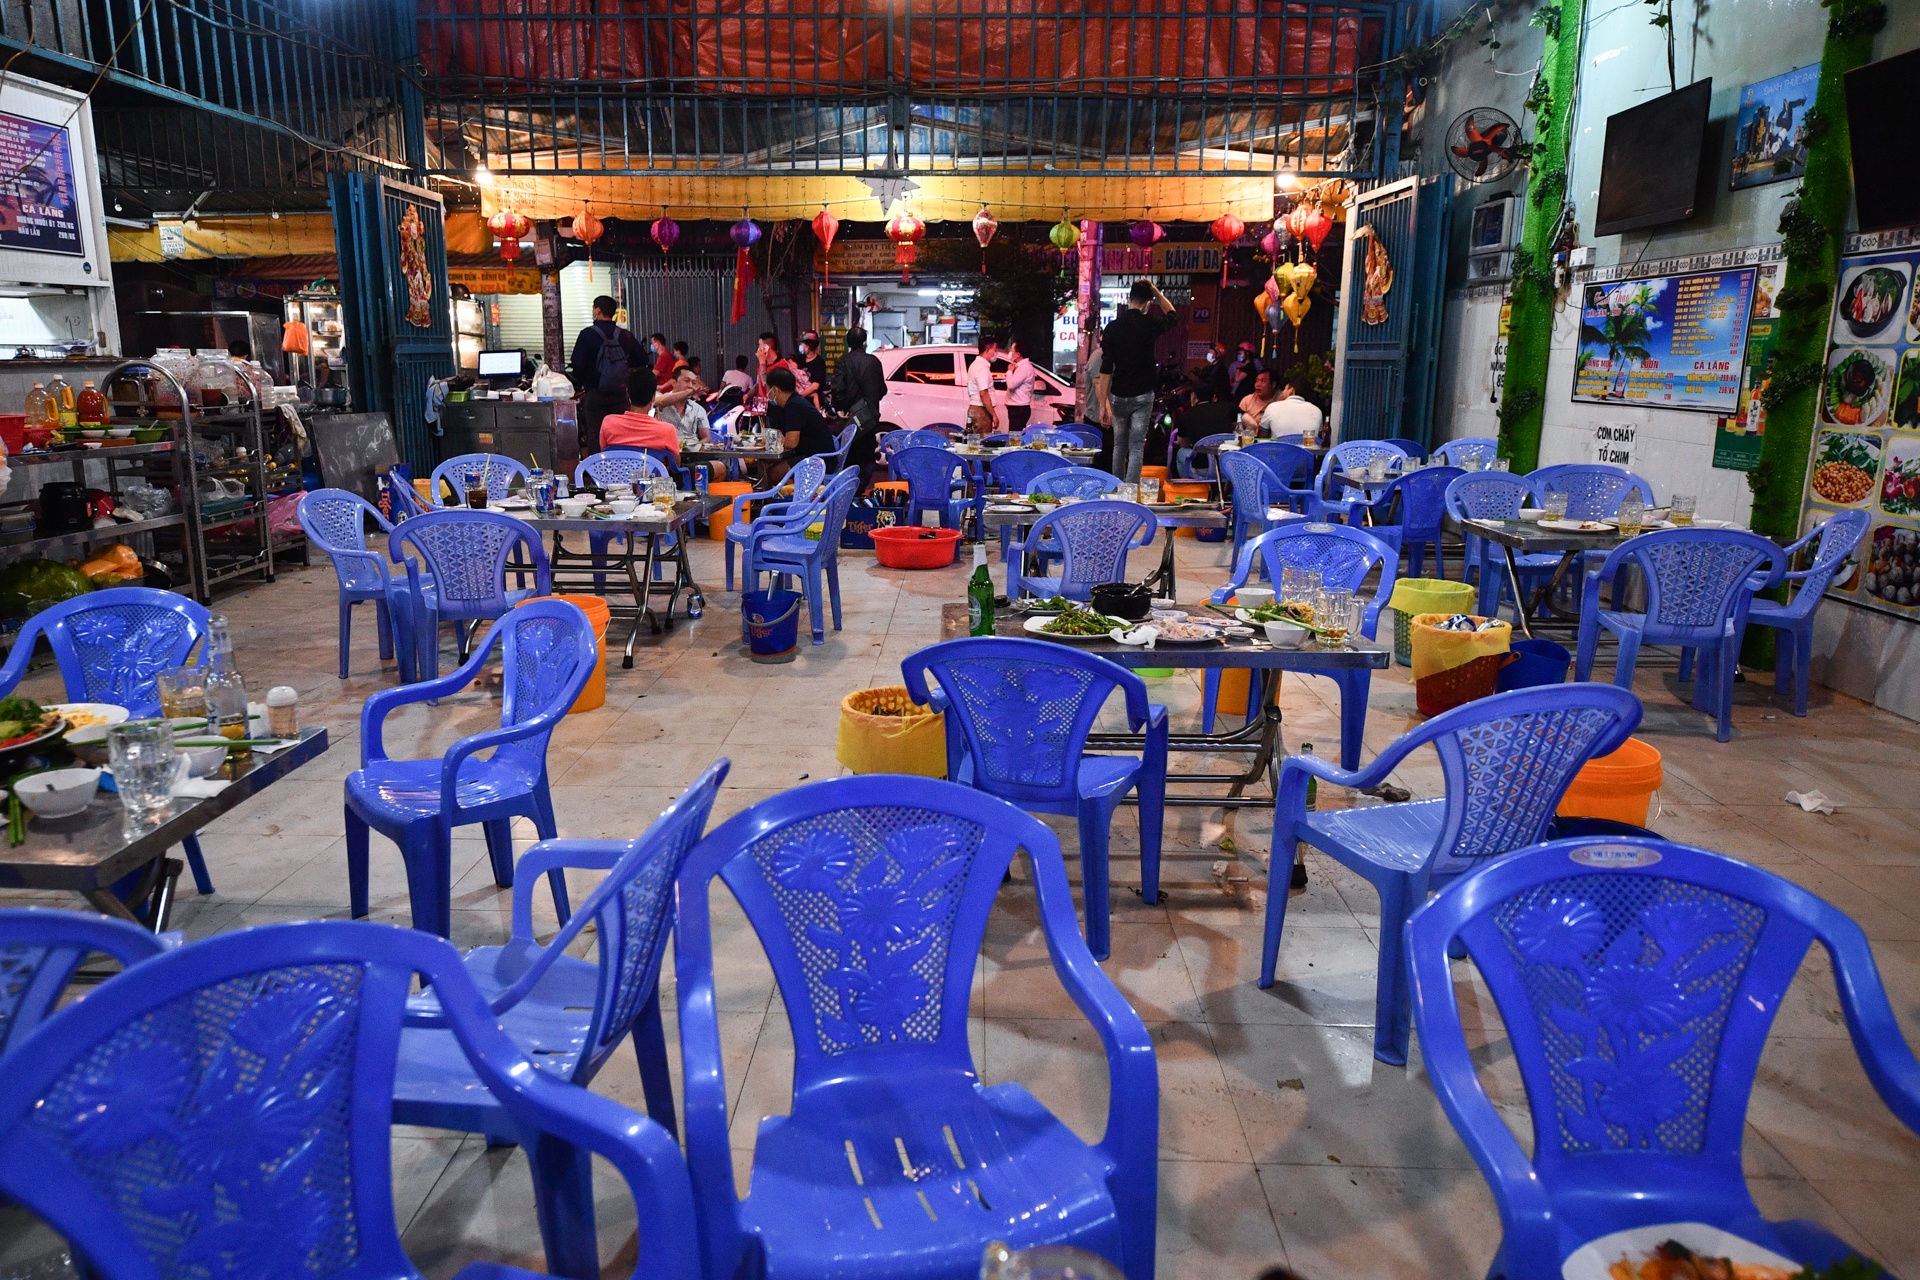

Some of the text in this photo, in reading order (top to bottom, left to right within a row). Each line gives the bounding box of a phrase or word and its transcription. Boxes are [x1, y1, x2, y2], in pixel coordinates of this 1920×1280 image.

[22, 203, 36, 214] CÁ
[1102, 249, 1124, 271] ANH
[1165, 246, 1199, 270] BÁNH
[1202, 249, 1220, 270] ĐA
[614, 311, 628, 324] 76
[1694, 359, 1705, 370] CÁ
[1597, 425, 1635, 442] CƠM CHÁY
[1598, 442, 1629, 465] TỔ CHIM
[378, 490, 392, 520] Tiger
[847, 520, 874, 535] Tiger
